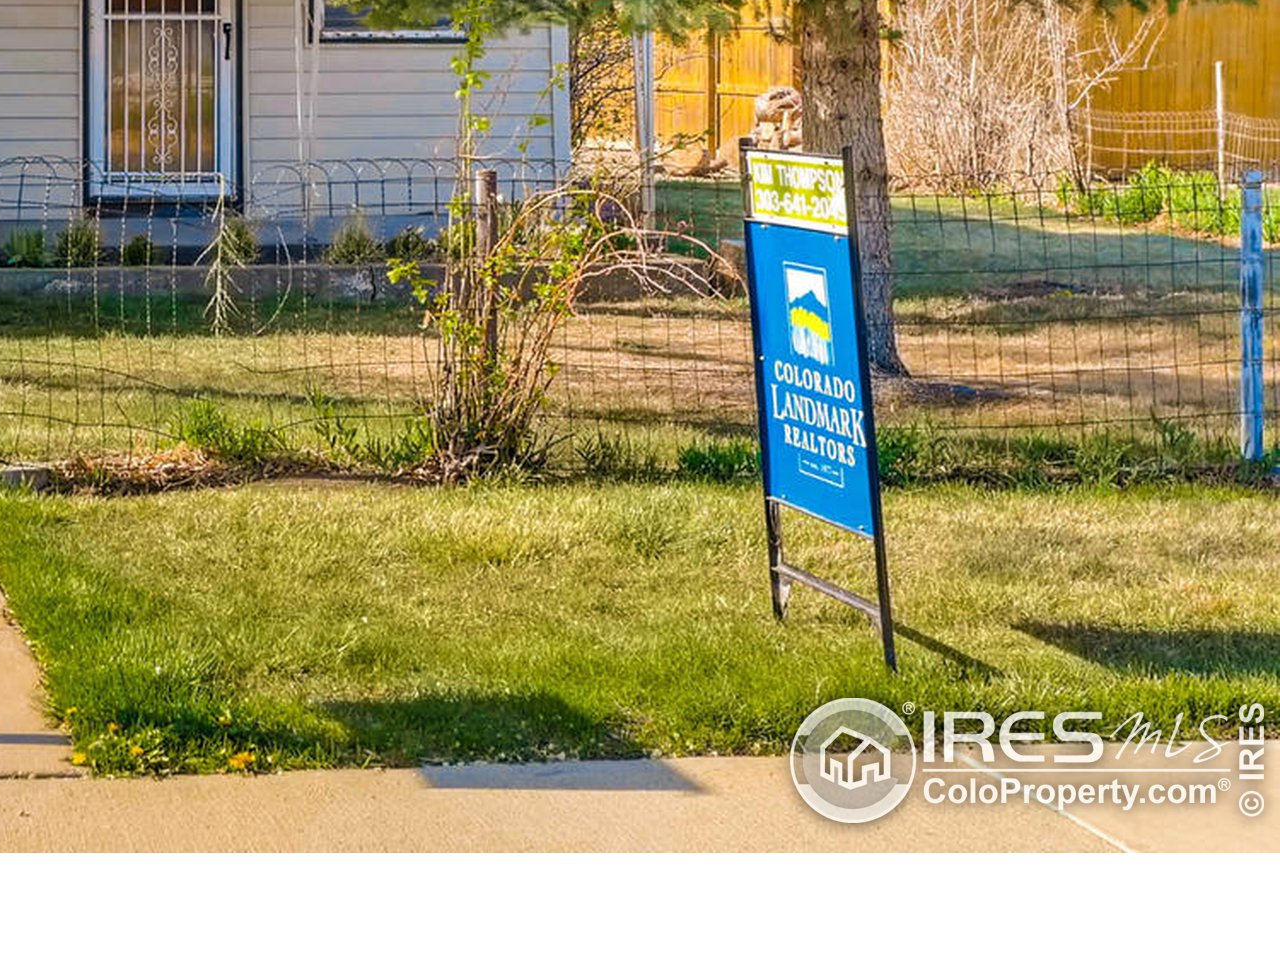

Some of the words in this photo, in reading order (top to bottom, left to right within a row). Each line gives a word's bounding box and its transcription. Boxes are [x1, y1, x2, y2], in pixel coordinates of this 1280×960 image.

[777, 164, 844, 193] THOMPSON
[774, 360, 855, 403] COLORADO
[771, 383, 867, 448] LANDMARK
[784, 423, 856, 468] REALTORS
